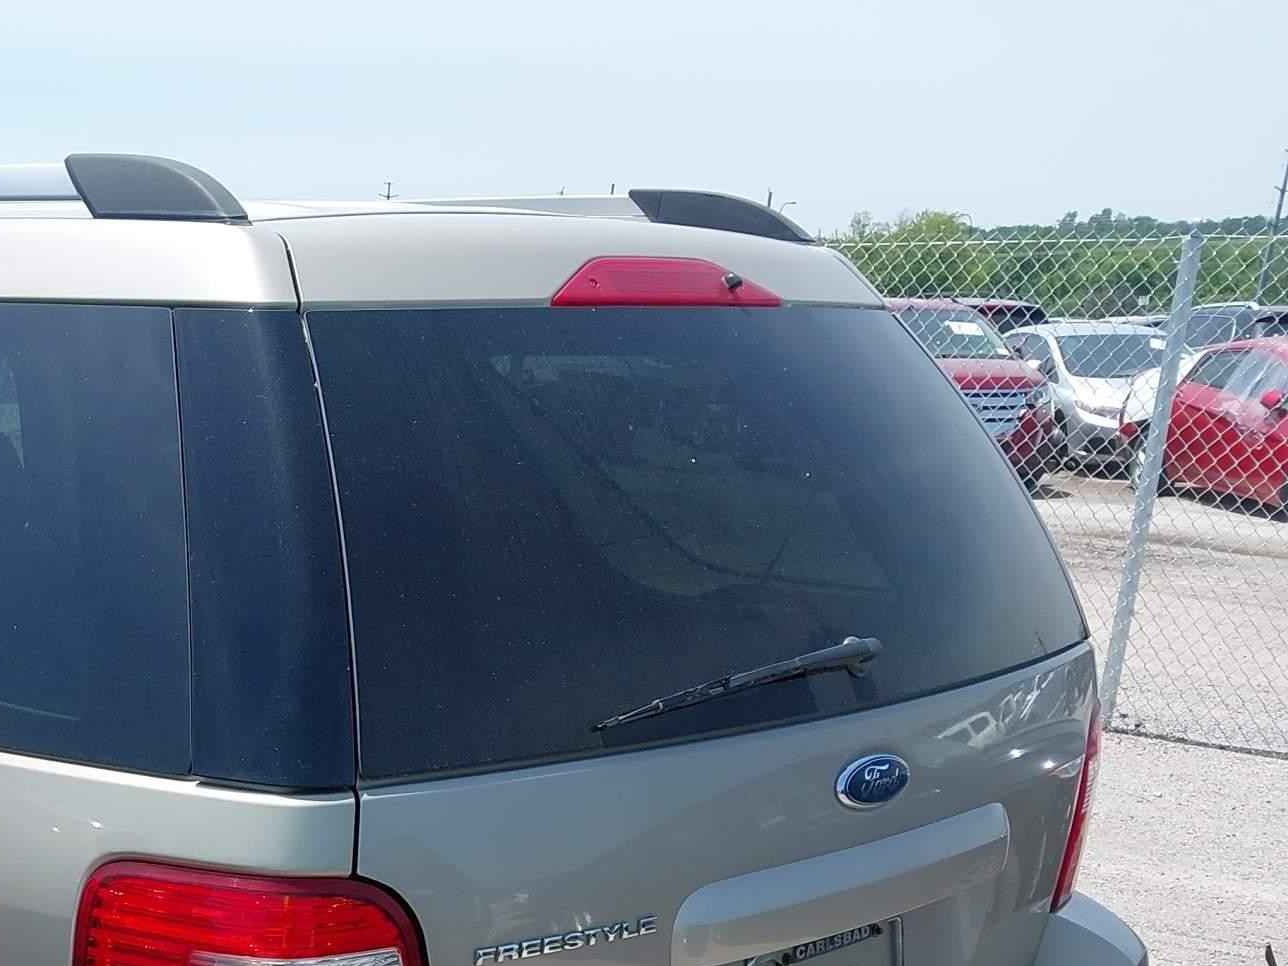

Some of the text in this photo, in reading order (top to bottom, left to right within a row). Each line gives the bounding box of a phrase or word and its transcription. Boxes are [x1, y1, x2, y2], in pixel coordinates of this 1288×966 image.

[860, 762, 901, 795] Ford
[474, 914, 659, 966] FREESTYLE
[795, 925, 871, 960] CARLSBAD
